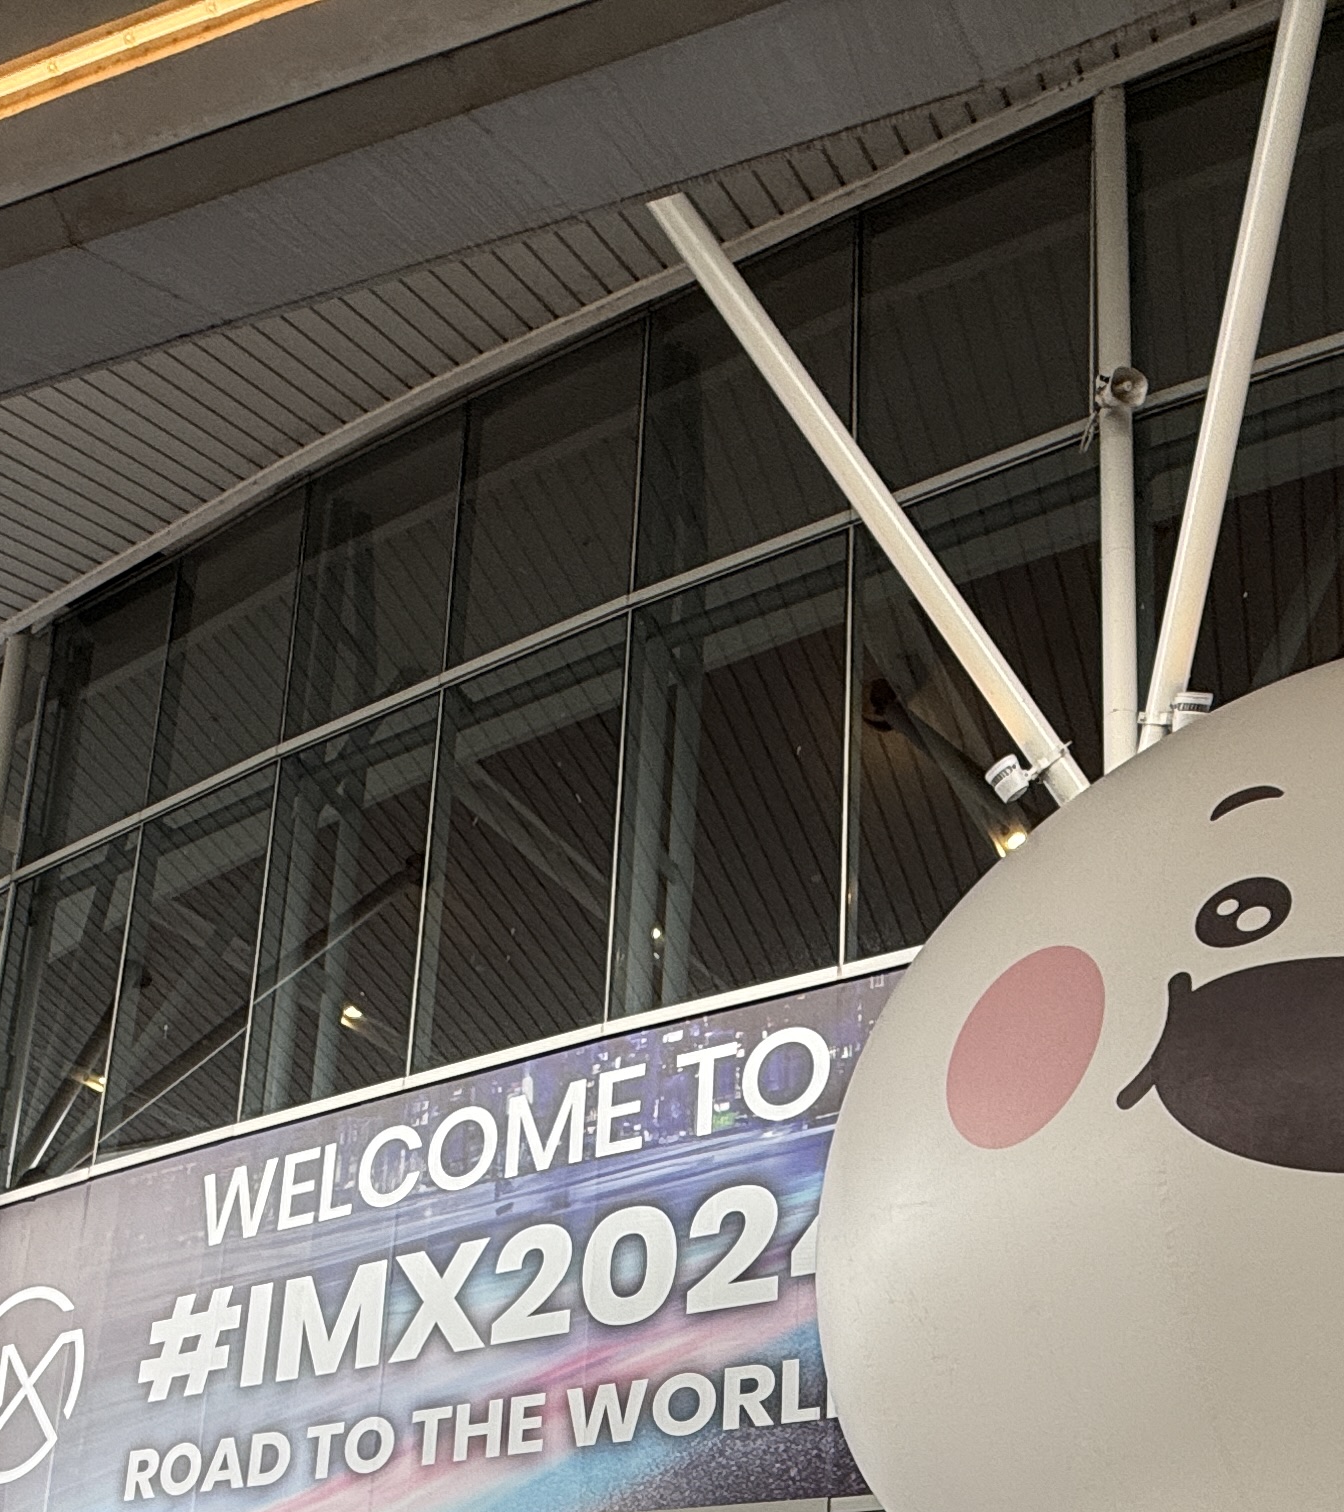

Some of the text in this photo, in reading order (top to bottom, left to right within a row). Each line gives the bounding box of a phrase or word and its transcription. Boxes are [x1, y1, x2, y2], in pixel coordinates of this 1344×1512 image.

[202, 1026, 831, 1247] WELCOME TO
[123, 1357, 837, 1503] ROAD TO THE WORL
